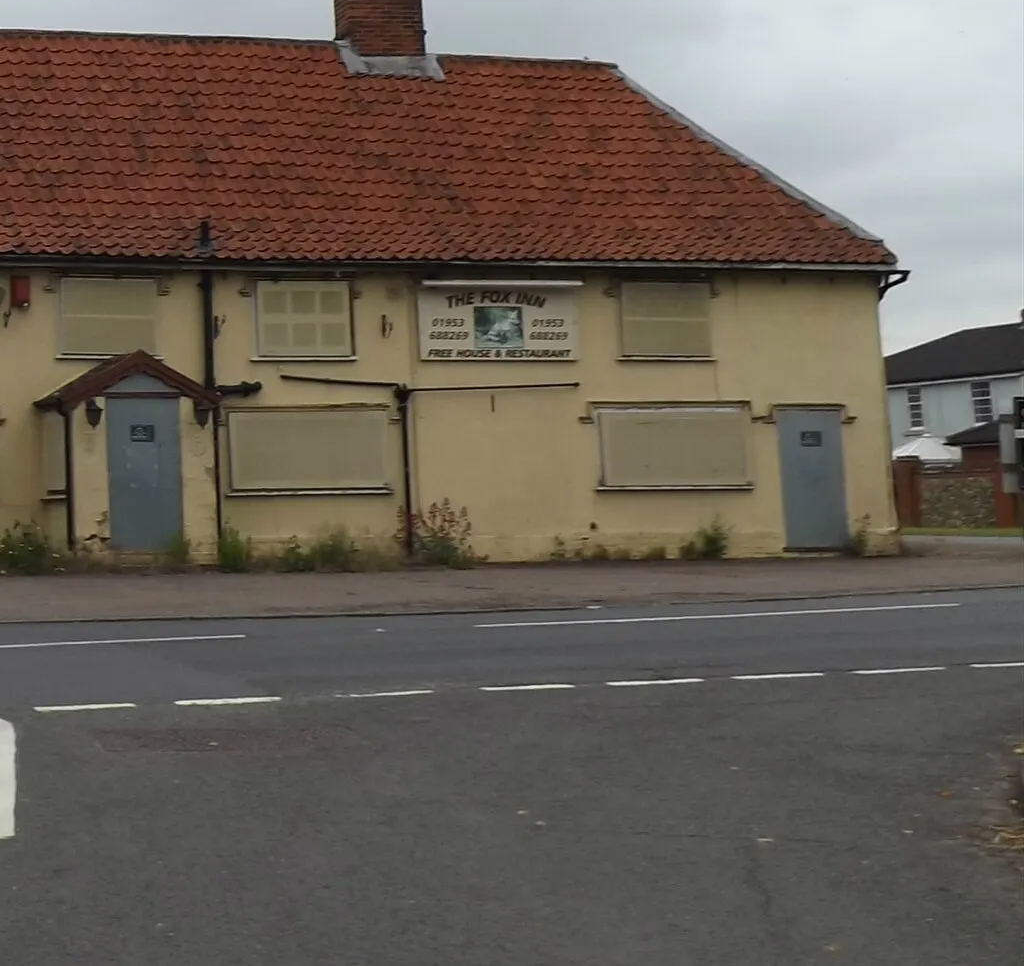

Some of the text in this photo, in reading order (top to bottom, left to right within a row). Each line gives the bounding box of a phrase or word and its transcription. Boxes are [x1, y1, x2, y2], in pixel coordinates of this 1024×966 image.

[446, 290, 547, 309] THE FOX INN
[431, 318, 465, 327] 01953
[531, 318, 565, 328] 01953
[427, 349, 454, 358] FREE
[456, 349, 492, 358] HOUSE
[505, 349, 572, 358] RESTAURANT
